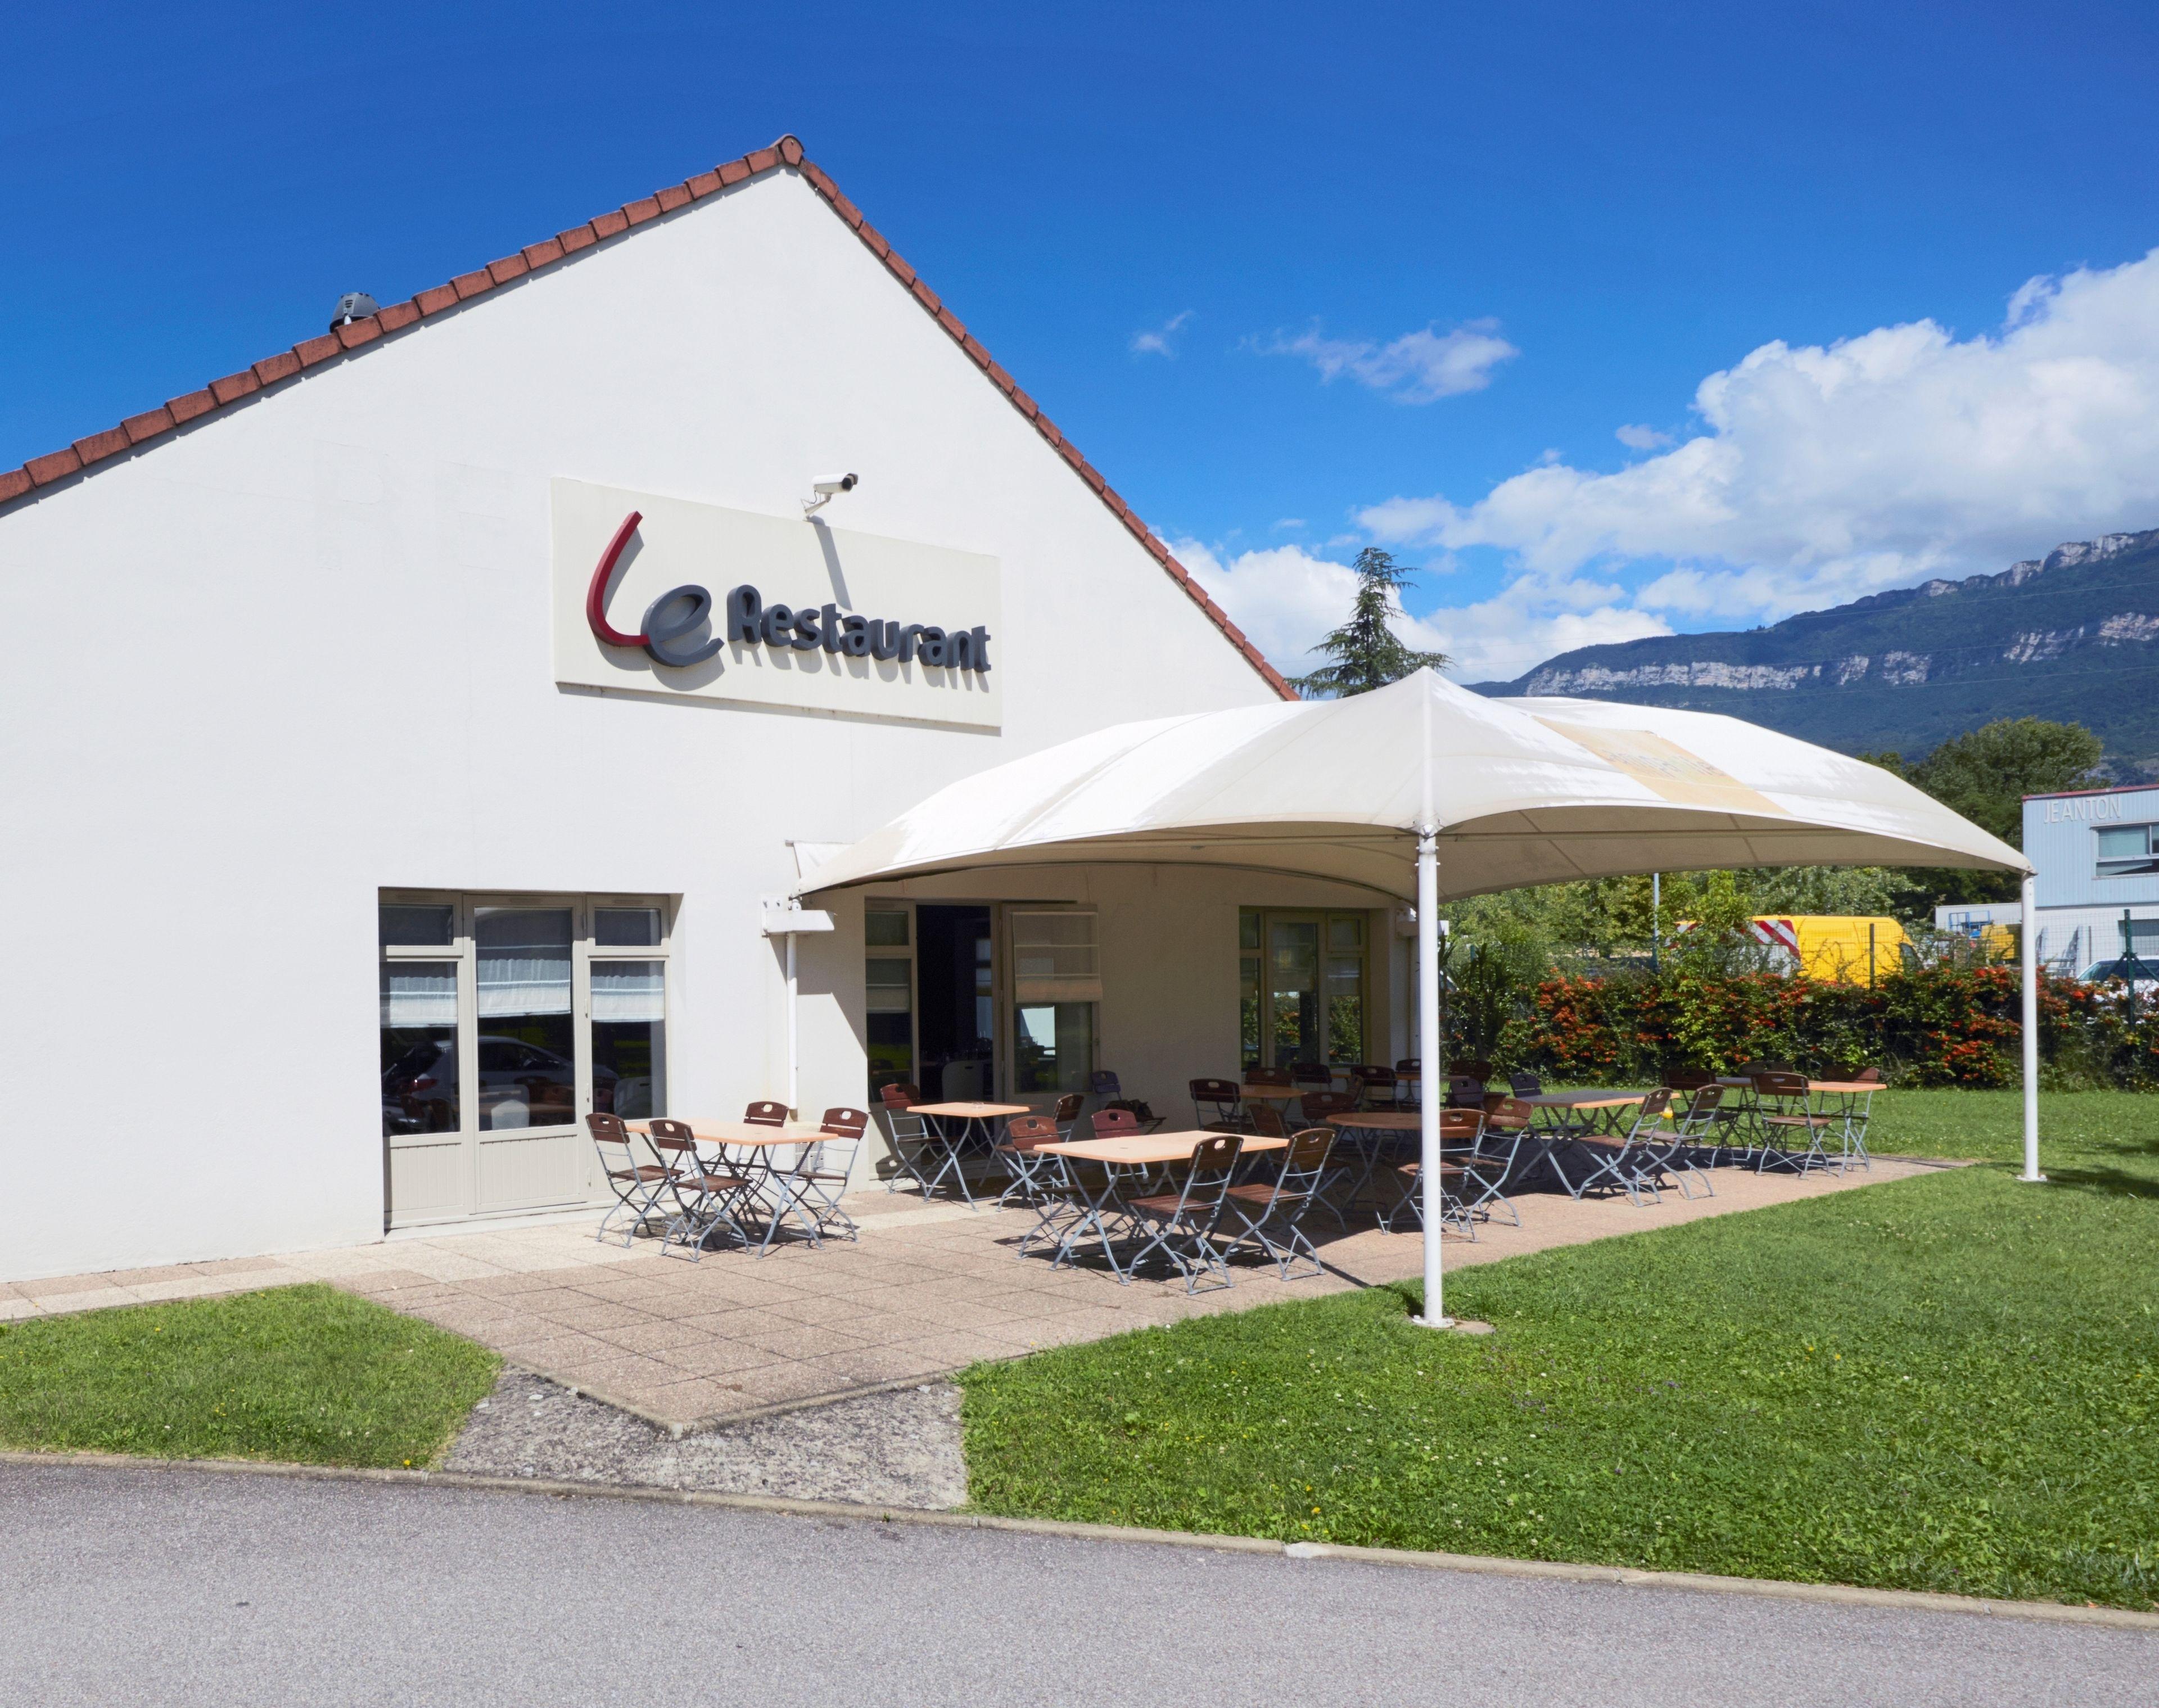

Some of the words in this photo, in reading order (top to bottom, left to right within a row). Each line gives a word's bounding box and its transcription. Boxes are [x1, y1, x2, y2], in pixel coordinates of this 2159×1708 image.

[586, 510, 724, 667] Le
[726, 584, 991, 672] Restaurant
[2044, 796, 2121, 823] JEANTON
